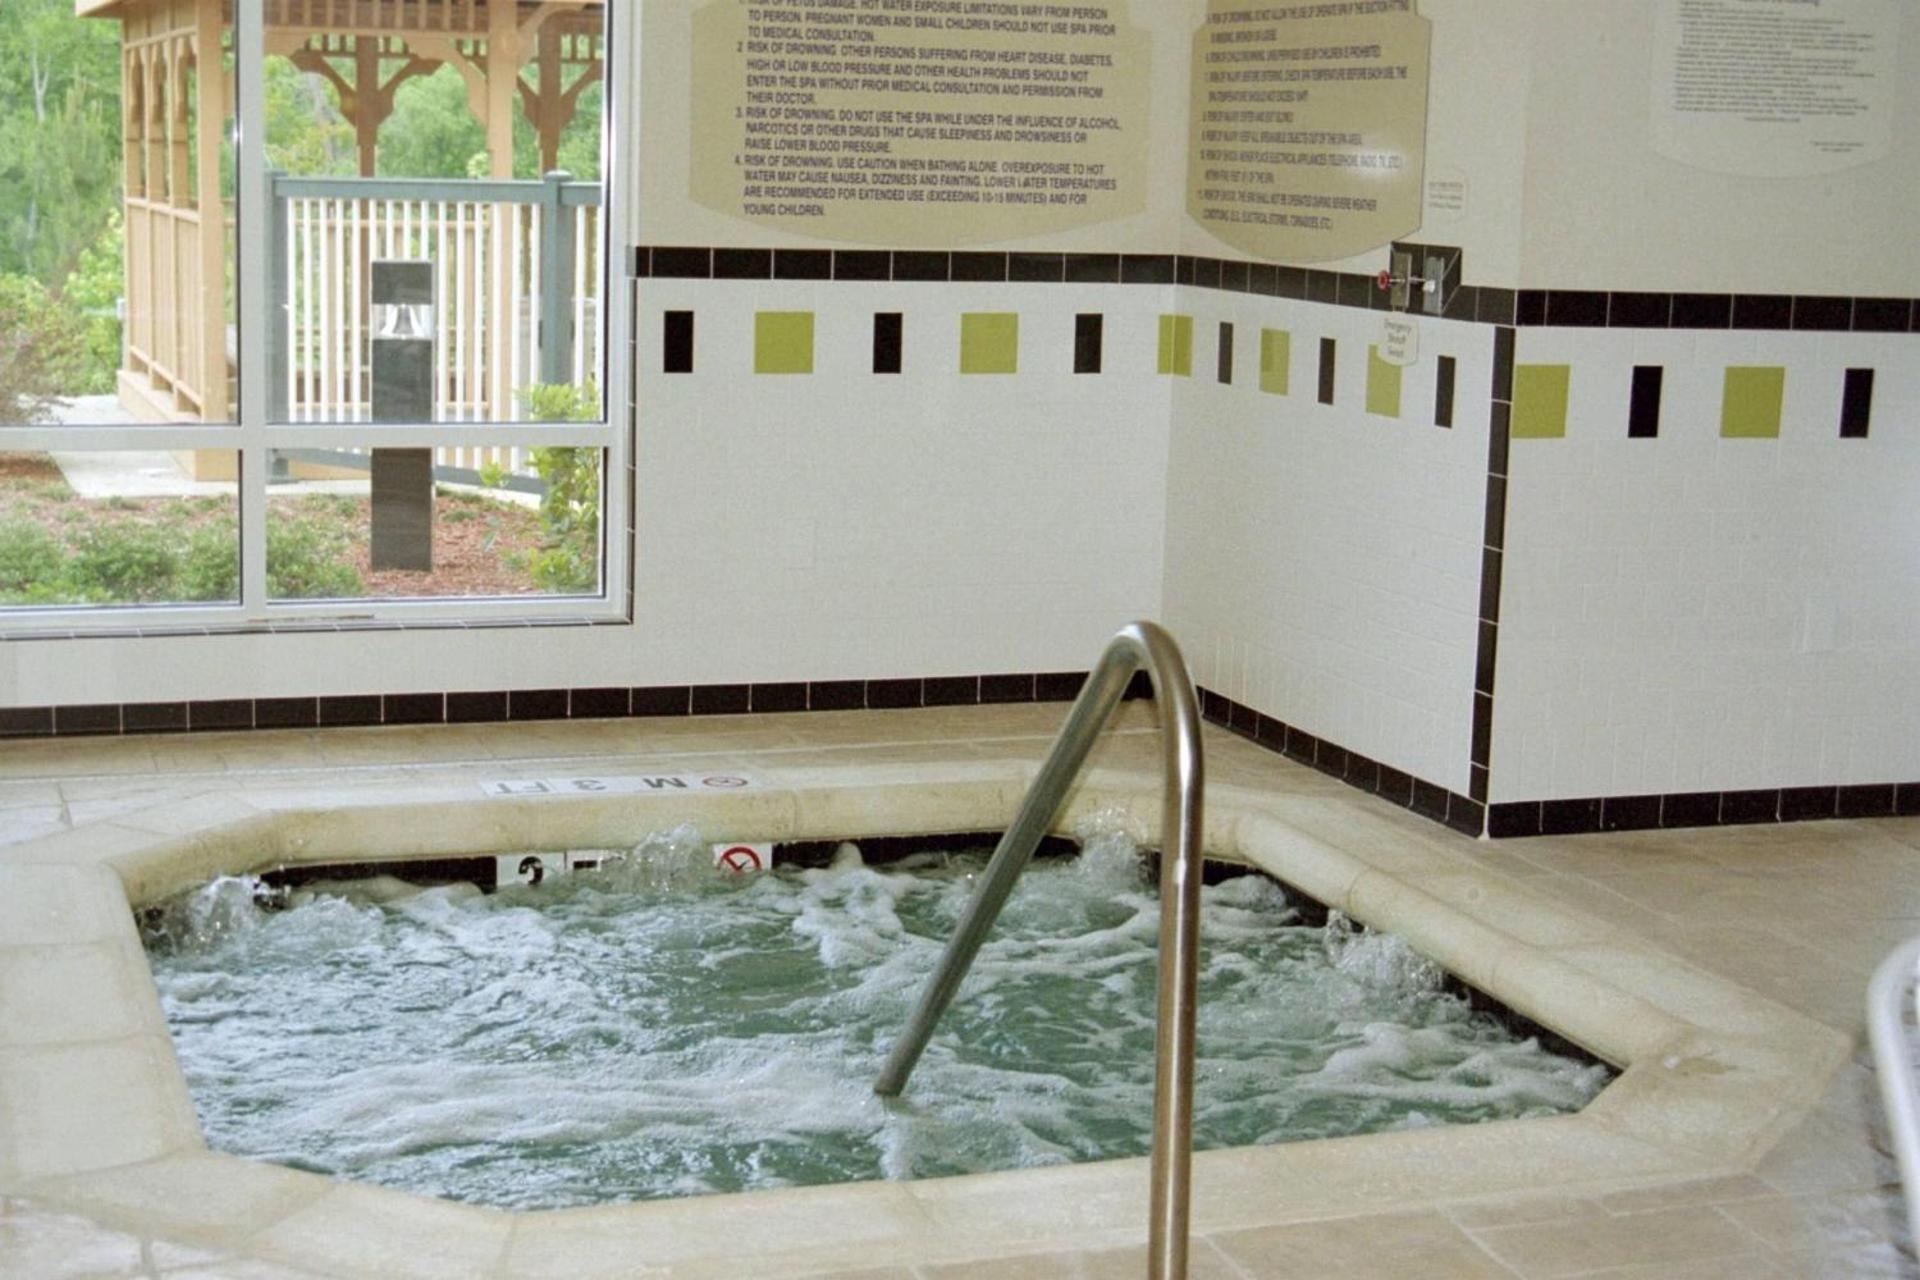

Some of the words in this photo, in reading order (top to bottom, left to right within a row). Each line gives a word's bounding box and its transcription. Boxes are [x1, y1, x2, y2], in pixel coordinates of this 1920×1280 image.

[882, 0, 912, 11] WATER
[914, 0, 961, 13] EXPOSURE
[963, 2, 1018, 15] LIMITATIONS
[1020, 4, 1042, 16] VARY
[1044, 5, 1070, 17] FROM
[1072, 6, 1108, 19] PERSON
[748, 10, 760, 22] TO
[805, 12, 853, 25] PREGNANT
[856, 15, 891, 27] WOMEN
[893, 16, 911, 28] AND
[914, 17, 942, 29] SMALL
[945, 18, 990, 30] CHILDREN
[992, 20, 1028, 32] SHOULD
[1030, 21, 1047, 33] NOT
[1050, 22, 1067, 33] USE
[1070, 23, 1086, 34] SPA
[1088, 24, 1116, 35] PRIOR
[748, 27, 760, 39] TO
[762, 28, 801, 40] MEDICAL
[747, 42, 768, 54] RISK
[770, 43, 782, 54] OF
[840, 46, 871, 58] OTHER
[873, 47, 915, 59] PERSONS
[918, 48, 967, 61] SUFFERING
[969, 50, 995, 62] FROM
[997, 51, 1025, 63] HEART
[746, 60, 770, 71] HIGH
[772, 61, 785, 72] OR
[788, 61, 808, 72] LOW
[810, 62, 842, 74] BLOOD
[843, 63, 890, 75] PRESSURE
[893, 65, 912, 76] AND
[914, 66, 944, 77] OTHER
[946, 67, 980, 78] HEALTH
[982, 68, 1030, 80] PROBLEMS
[1032, 70, 1068, 81] SHOULD
[1070, 71, 1088, 82] NOT
[746, 76, 776, 88] ENTER
[780, 77, 796, 89] THE
[799, 78, 816, 89] SPA
[818, 79, 858, 91] WITHOUT
[861, 80, 889, 92] PRIOR
[891, 81, 930, 93] MEDICAL
[933, 82, 999, 95] CONSULTATION
[1002, 85, 1019, 96] AND
[1077, 87, 1104, 98] FROM
[746, 92, 773, 103] THEIR
[745, 107, 766, 119] RISK
[769, 108, 781, 119] OF
[838, 110, 852, 121] DO
[854, 110, 872, 122] NOT
[875, 111, 893, 122] USE
[896, 112, 912, 123] THE
[914, 112, 932, 124] SPA
[934, 113, 961, 124] WHILE
[963, 114, 994, 125] UNDER
[996, 115, 1012, 126] THE
[1015, 115, 1062, 127] INFLUENCE
[1065, 117, 1076, 128] OF
[746, 123, 798, 136] NARCOTICS
[800, 125, 813, 136] OR
[816, 125, 846, 137] OTHER
[848, 126, 880, 138] DRUGS
[883, 127, 903, 138] THAT
[906, 128, 936, 139] CAUSE
[938, 129, 991, 141] SLEEPINESS
[994, 130, 1012, 141] AND
[1014, 131, 1071, 143] DROWSINESS
[1074, 132, 1088, 143] OR
[745, 139, 771, 150] RAISE
[774, 139, 806, 151] LOWER
[808, 140, 840, 151] BLOOD
[744, 155, 765, 166] RISK
[767, 156, 779, 167] OF
[836, 158, 854, 168] USE
[856, 158, 897, 170] CAUTION
[899, 159, 925, 170] WHEN
[927, 160, 966, 171] BATHING
[1002, 162, 1070, 174] OVEREXPOSURE
[1073, 164, 1084, 174] TO
[1086, 164, 1104, 175] HOT
[744, 171, 775, 182] WATER
[777, 172, 796, 182] MAY
[798, 172, 828, 183] CAUSE
[871, 174, 917, 185] DIZZINESS
[919, 175, 938, 186] AND
[984, 176, 1015, 188] LOWER
[1050, 178, 1116, 190] TEMPERATURES
[744, 187, 761, 198] ARE
[764, 188, 835, 200] RECOMMENDED
[837, 189, 856, 200] FOR
[858, 190, 904, 201] EXTENDED
[906, 190, 923, 201] USE
[1049, 193, 1067, 204] AND
[1068, 194, 1088, 204] FOR
[744, 204, 775, 215] YOUNG
[572, 779, 606, 792] 3
